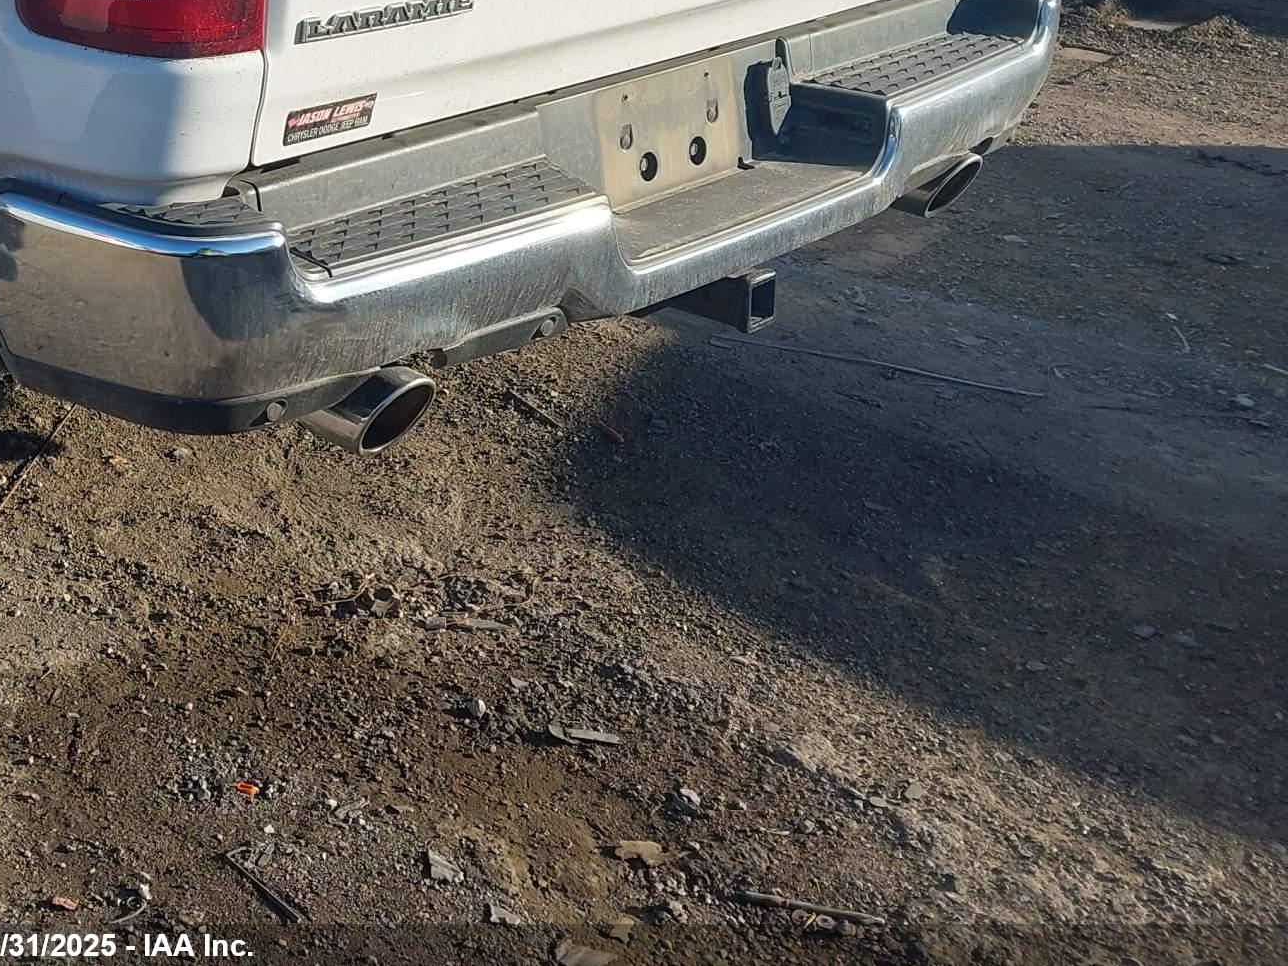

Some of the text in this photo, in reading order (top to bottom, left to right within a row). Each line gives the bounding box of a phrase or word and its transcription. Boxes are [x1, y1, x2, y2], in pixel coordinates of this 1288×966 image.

[296, 100, 366, 126] JASON LEWIS
[287, 115, 369, 143] CHRYSLER DODGE JEEP RAM
